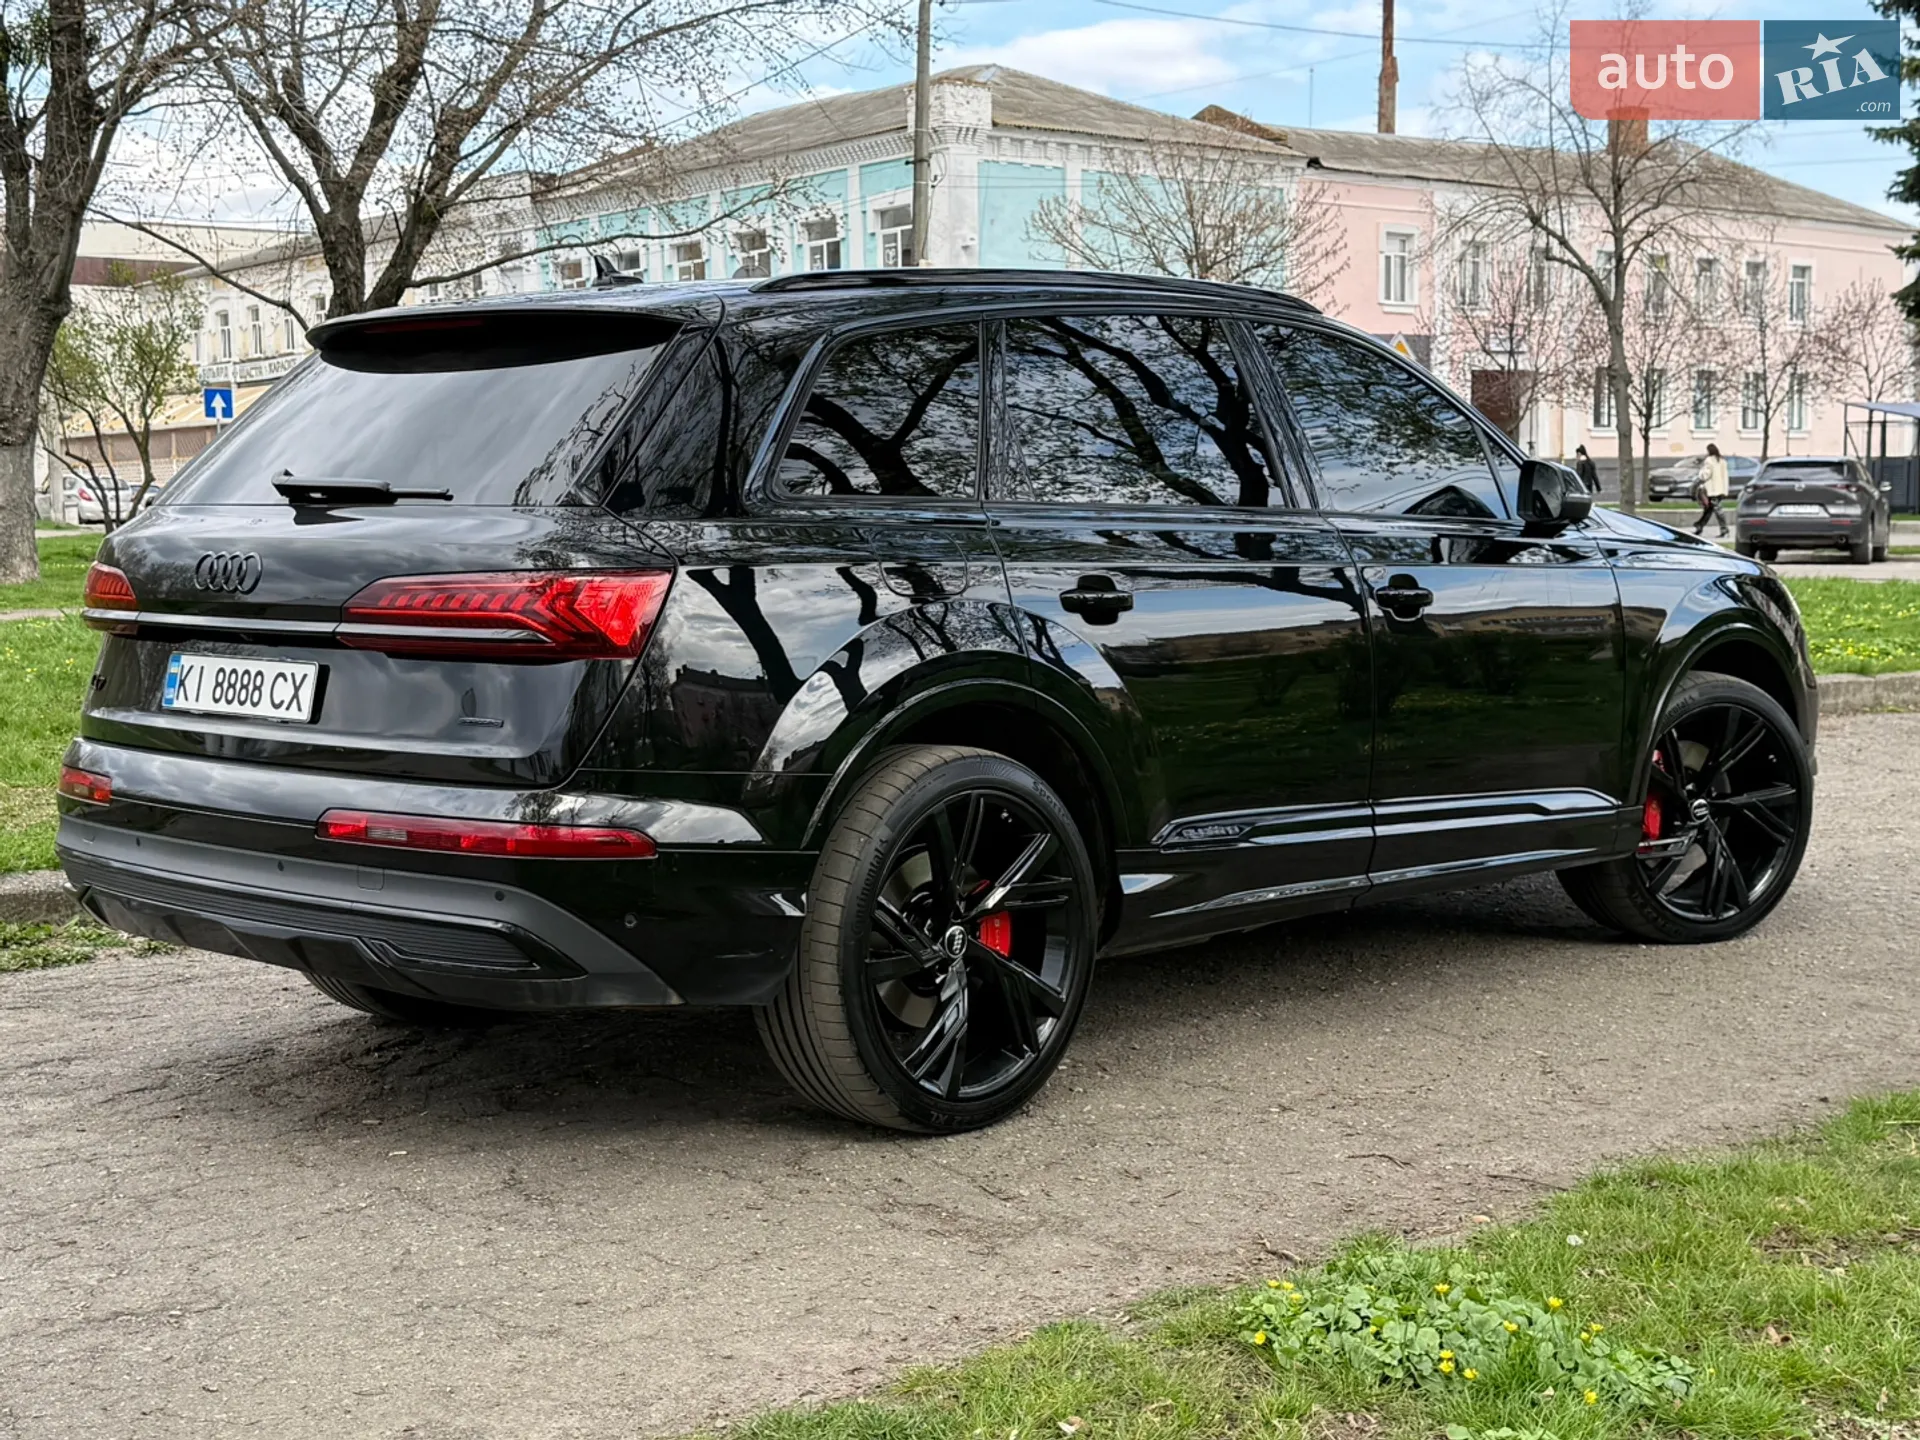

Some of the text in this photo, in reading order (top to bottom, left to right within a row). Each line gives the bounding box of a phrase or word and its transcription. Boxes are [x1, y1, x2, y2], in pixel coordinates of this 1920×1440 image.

[175, 664, 309, 713] KI 8888 CX
[851, 847, 884, 936] Continental
